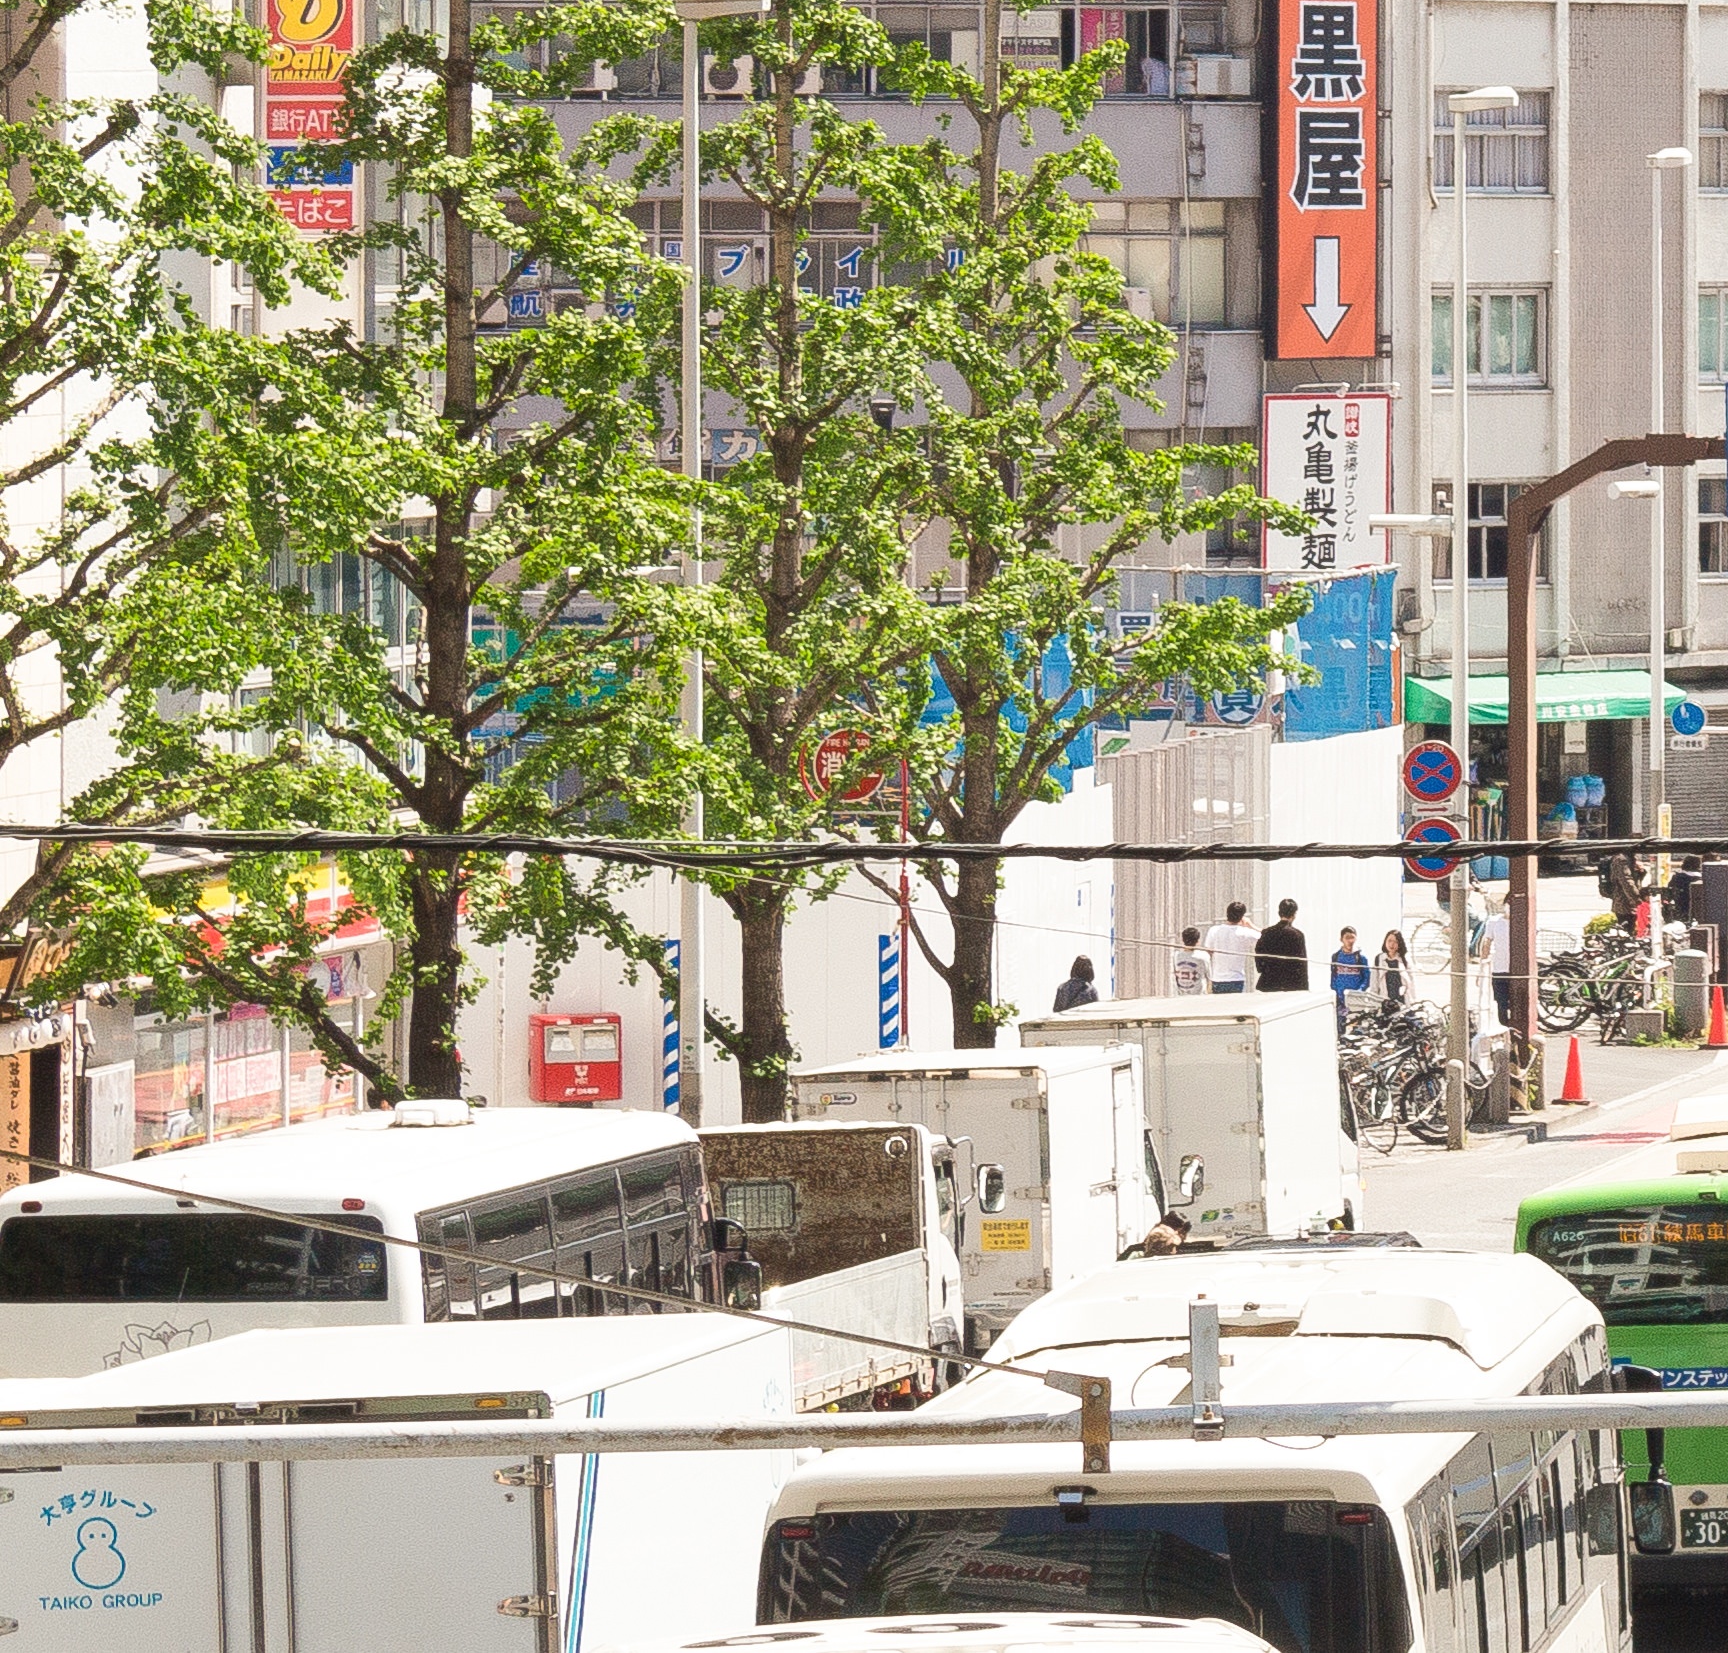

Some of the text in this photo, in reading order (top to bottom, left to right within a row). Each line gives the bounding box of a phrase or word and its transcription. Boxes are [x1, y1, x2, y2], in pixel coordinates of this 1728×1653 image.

[270, 45, 348, 74] Daily
[271, 107, 346, 132] 銀行AT
[1342, 440, 1359, 543] 釜揚げうどん
[1553, 1231, 1585, 1241] A626
[39, 1592, 163, 1610] TAIKO GROUP
